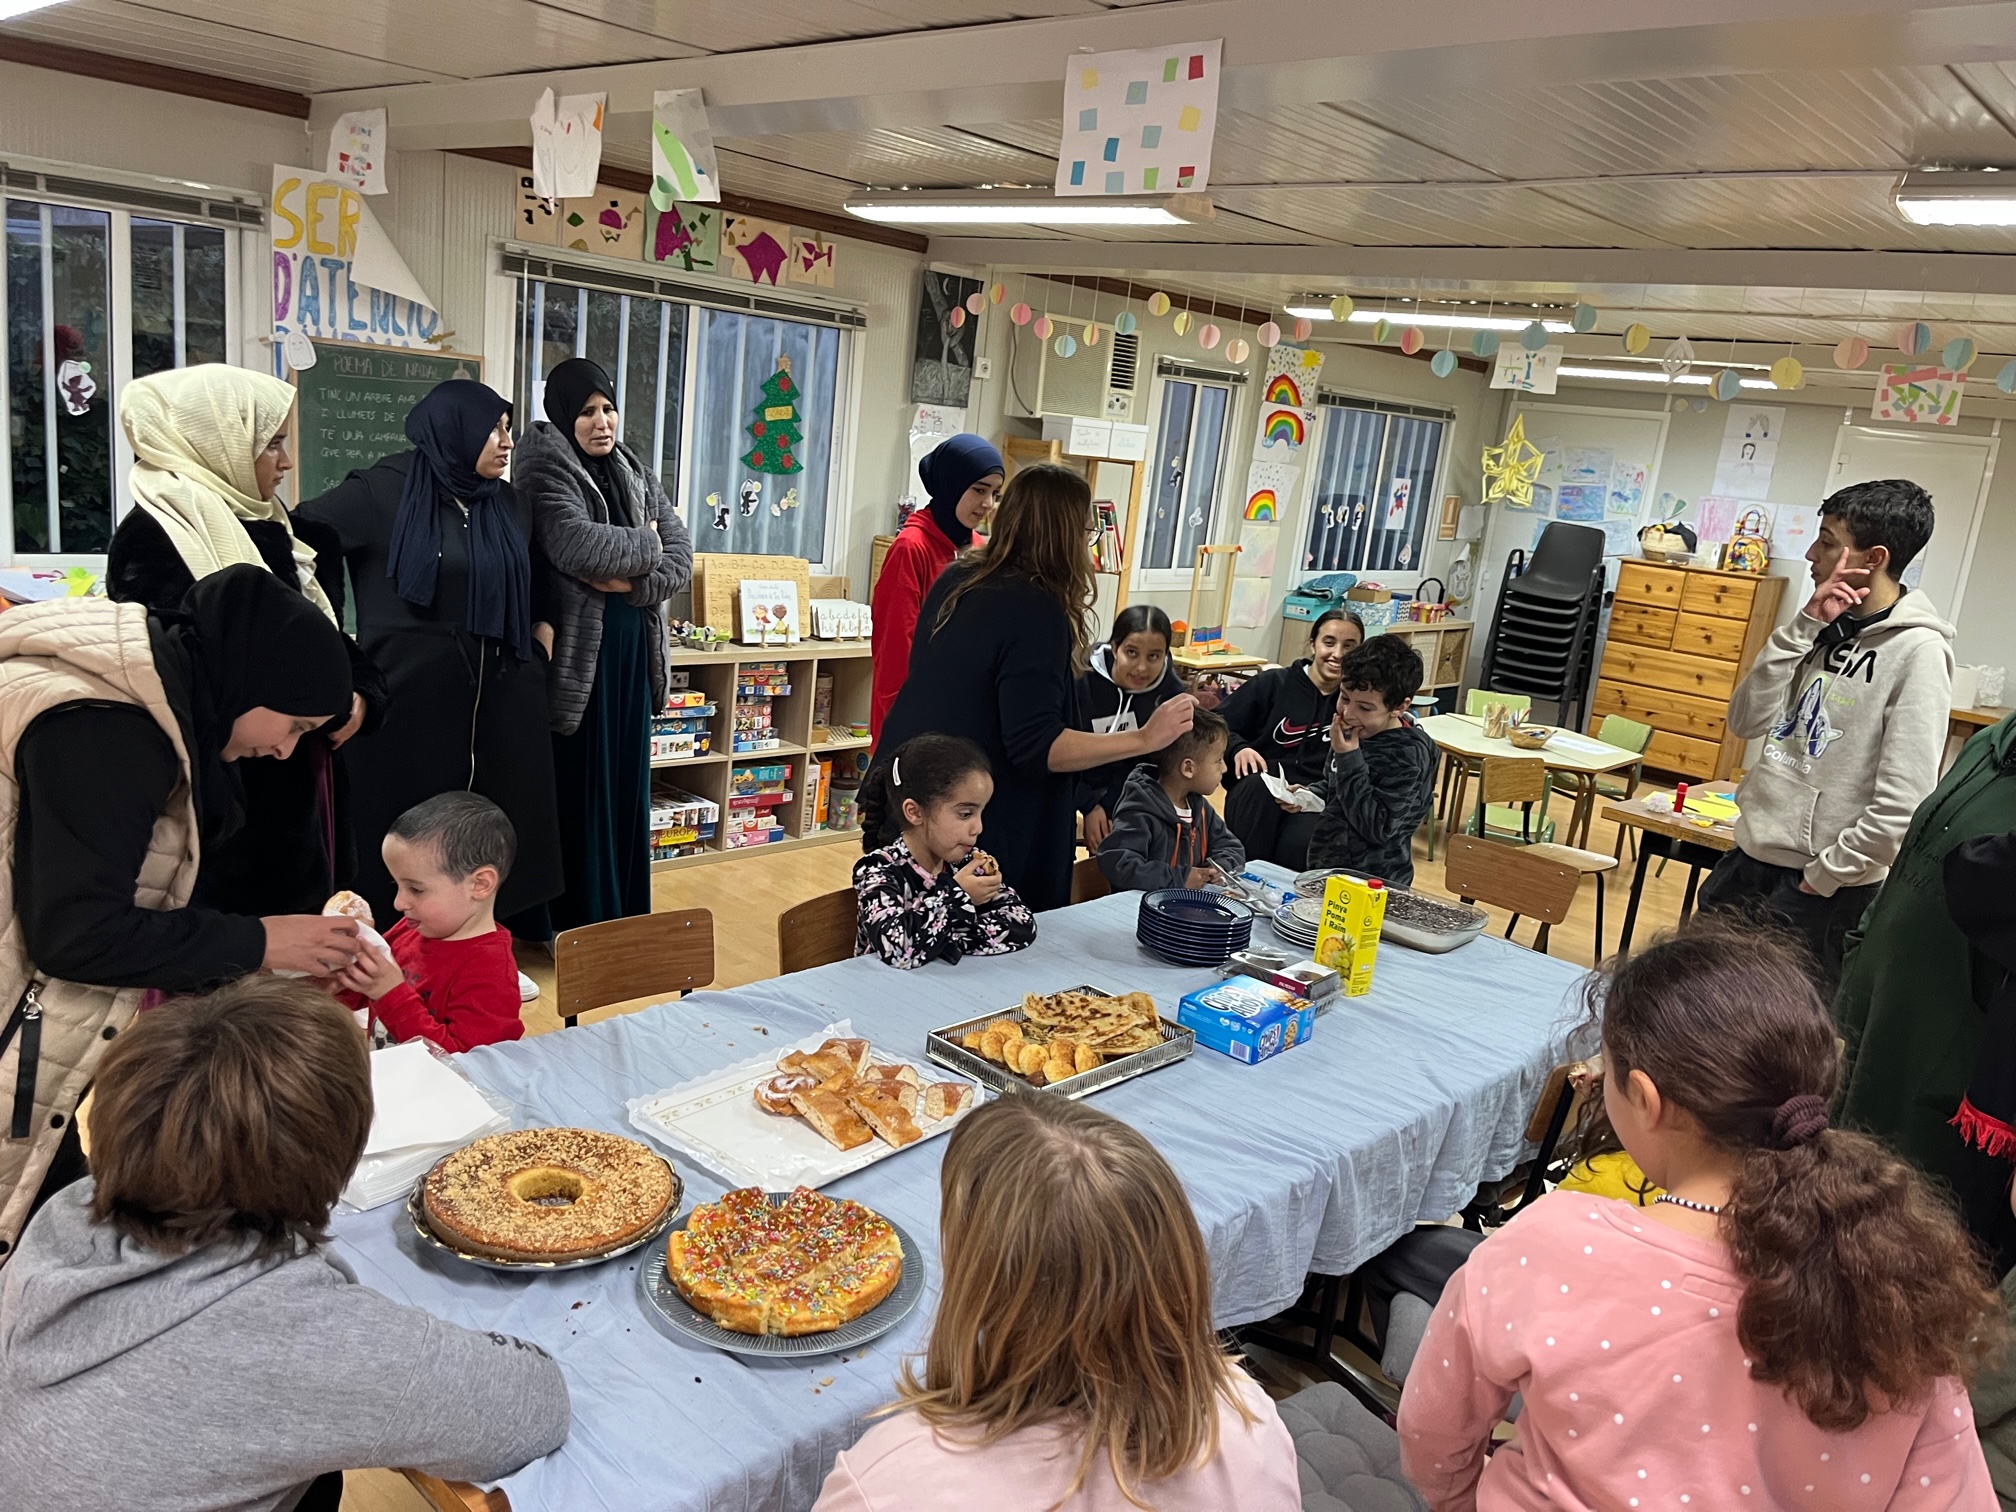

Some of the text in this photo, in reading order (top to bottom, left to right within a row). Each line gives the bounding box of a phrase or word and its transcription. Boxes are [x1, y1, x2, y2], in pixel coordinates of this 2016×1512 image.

[272, 177, 361, 257] SER
[332, 353, 442, 379] POEMA DE NADAL
[345, 392, 360, 402] UN
[383, 412, 396, 422] DE
[1763, 743, 1812, 775] Columia
[1327, 899, 1348, 914] Pinya
[1325, 909, 1346, 923] Poma
